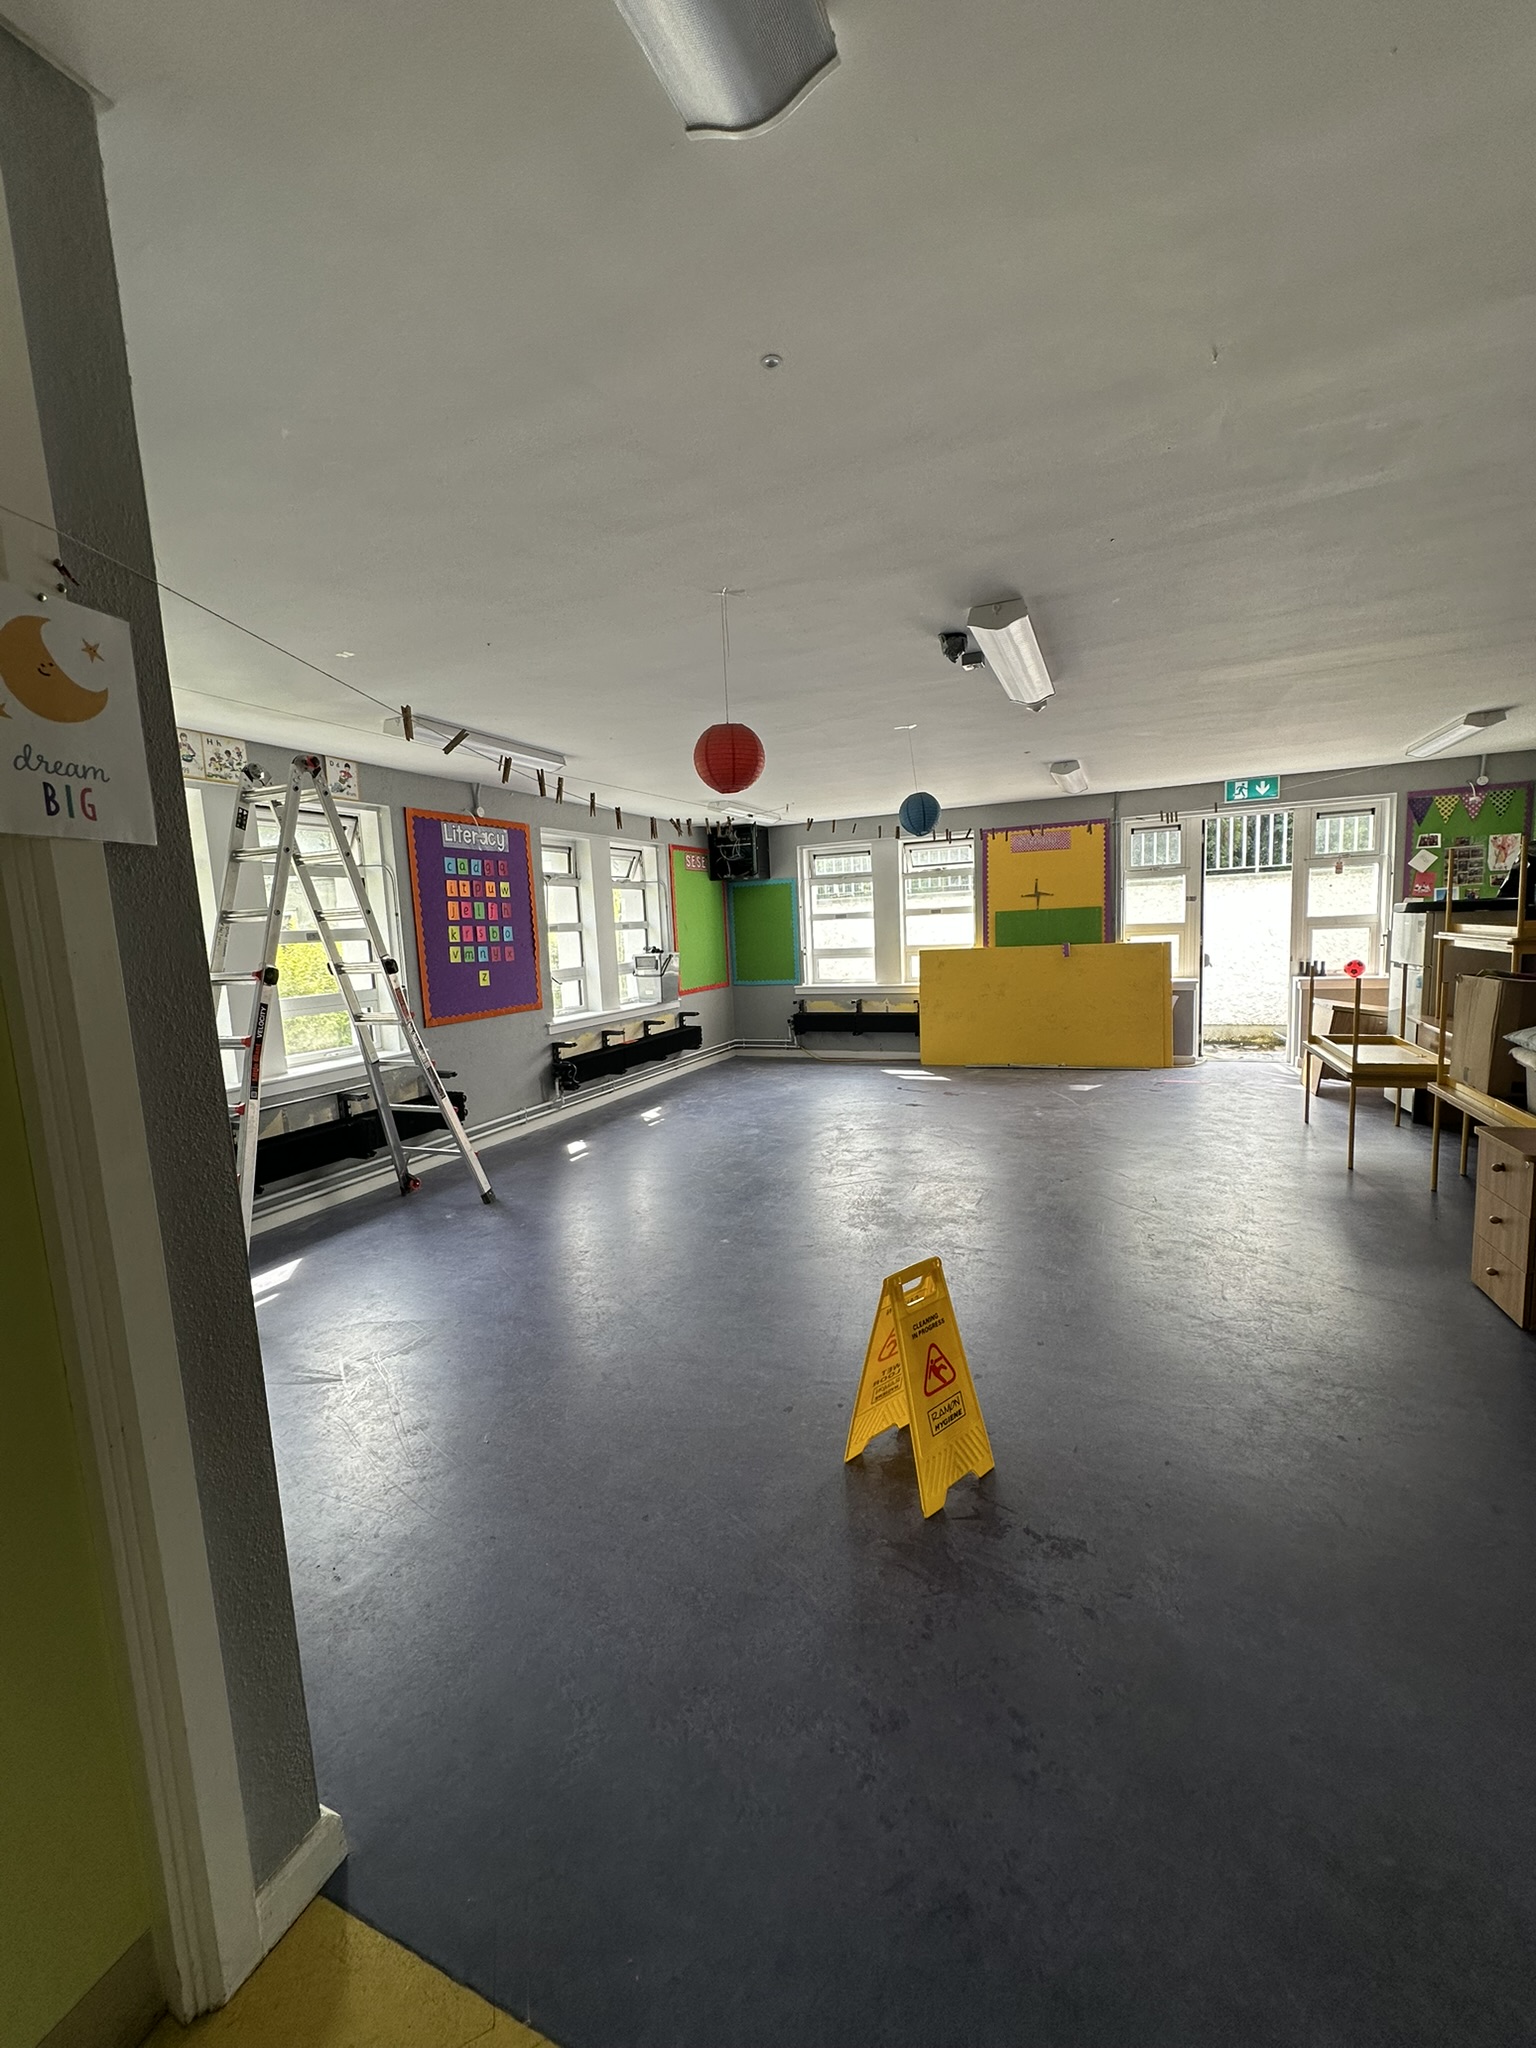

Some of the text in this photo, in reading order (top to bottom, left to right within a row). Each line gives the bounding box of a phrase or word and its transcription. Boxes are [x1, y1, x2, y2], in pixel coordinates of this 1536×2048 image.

[206, 738, 213, 746] H
[13, 744, 110, 783] dream
[42, 781, 97, 822] BIG
[443, 823, 505, 852] Literacy
[685, 854, 706, 869] SESE
[256, 1006, 267, 1039] VELOCITY
[911, 1318, 945, 1340] IN PROGRESS
[912, 1312, 939, 1331] CLEANING
[935, 1408, 962, 1431] HYGIENE
